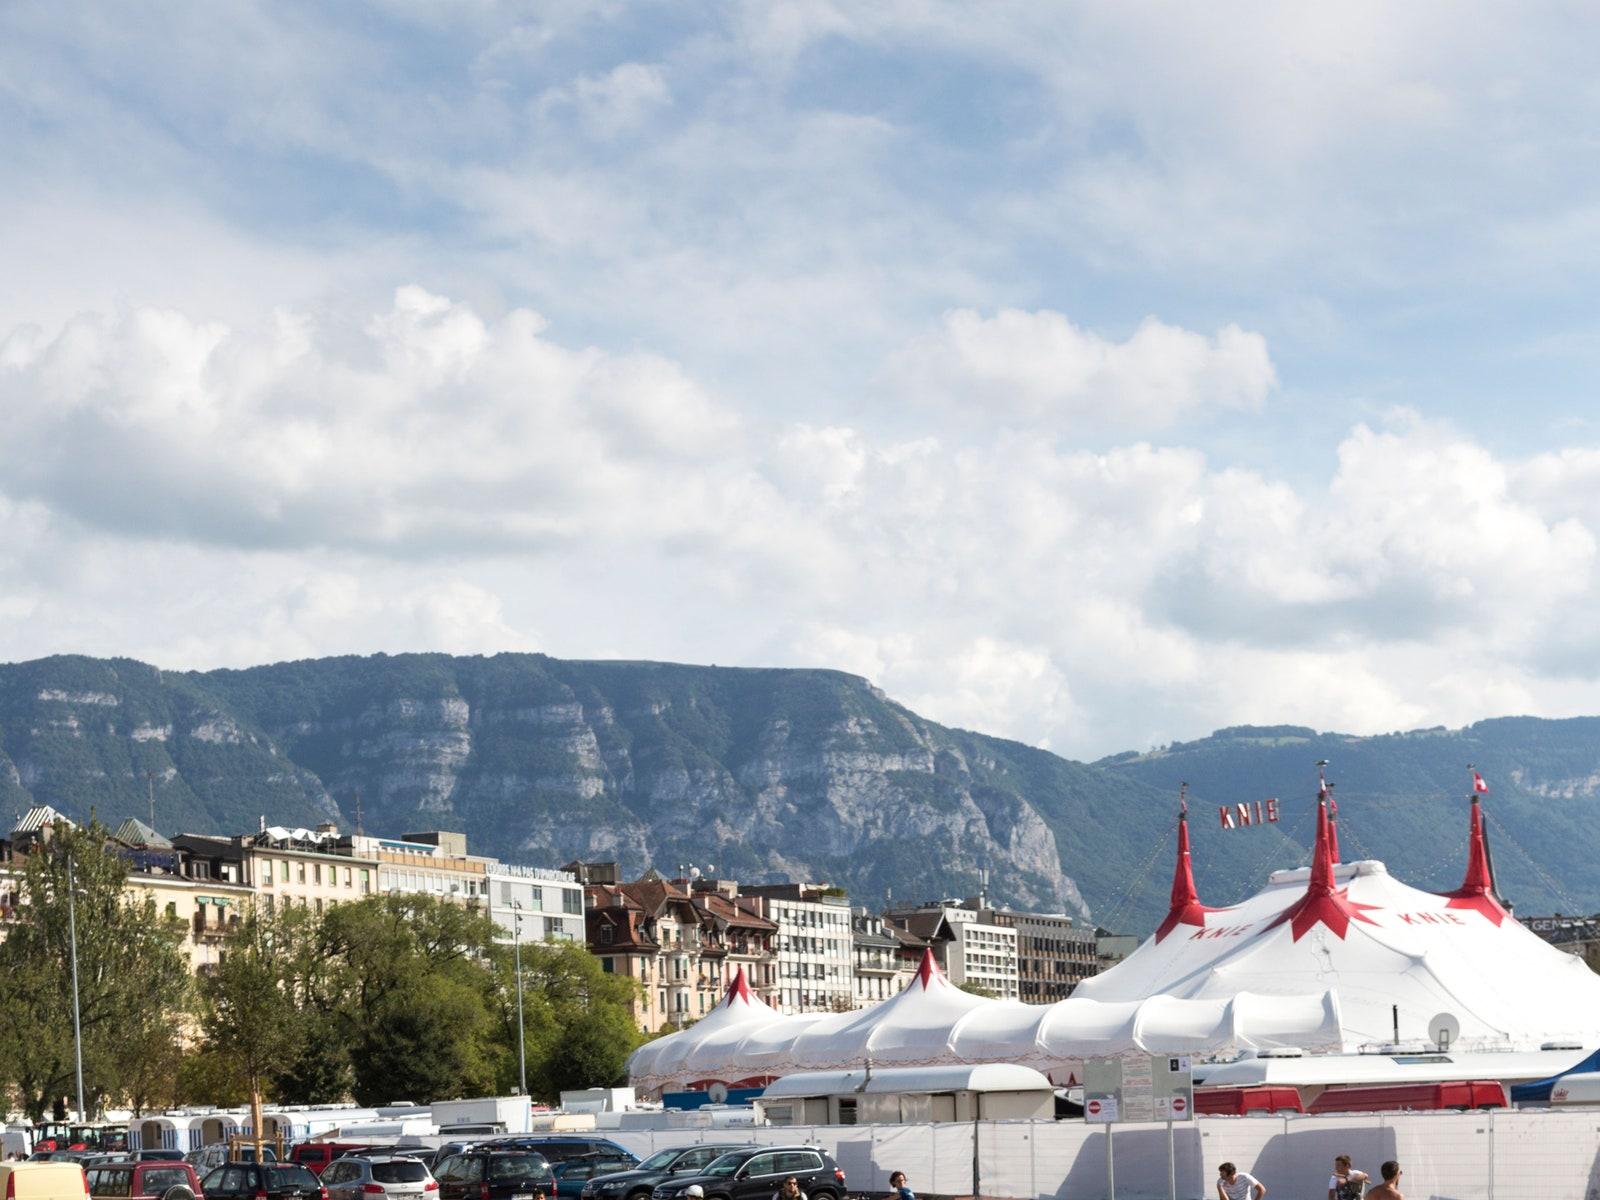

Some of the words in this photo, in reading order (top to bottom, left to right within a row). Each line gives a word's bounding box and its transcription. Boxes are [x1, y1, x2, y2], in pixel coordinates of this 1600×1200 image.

[1219, 798, 1279, 829] KNIE
[1397, 912, 1466, 925] KNIE
[1188, 924, 1254, 940] KNIE
